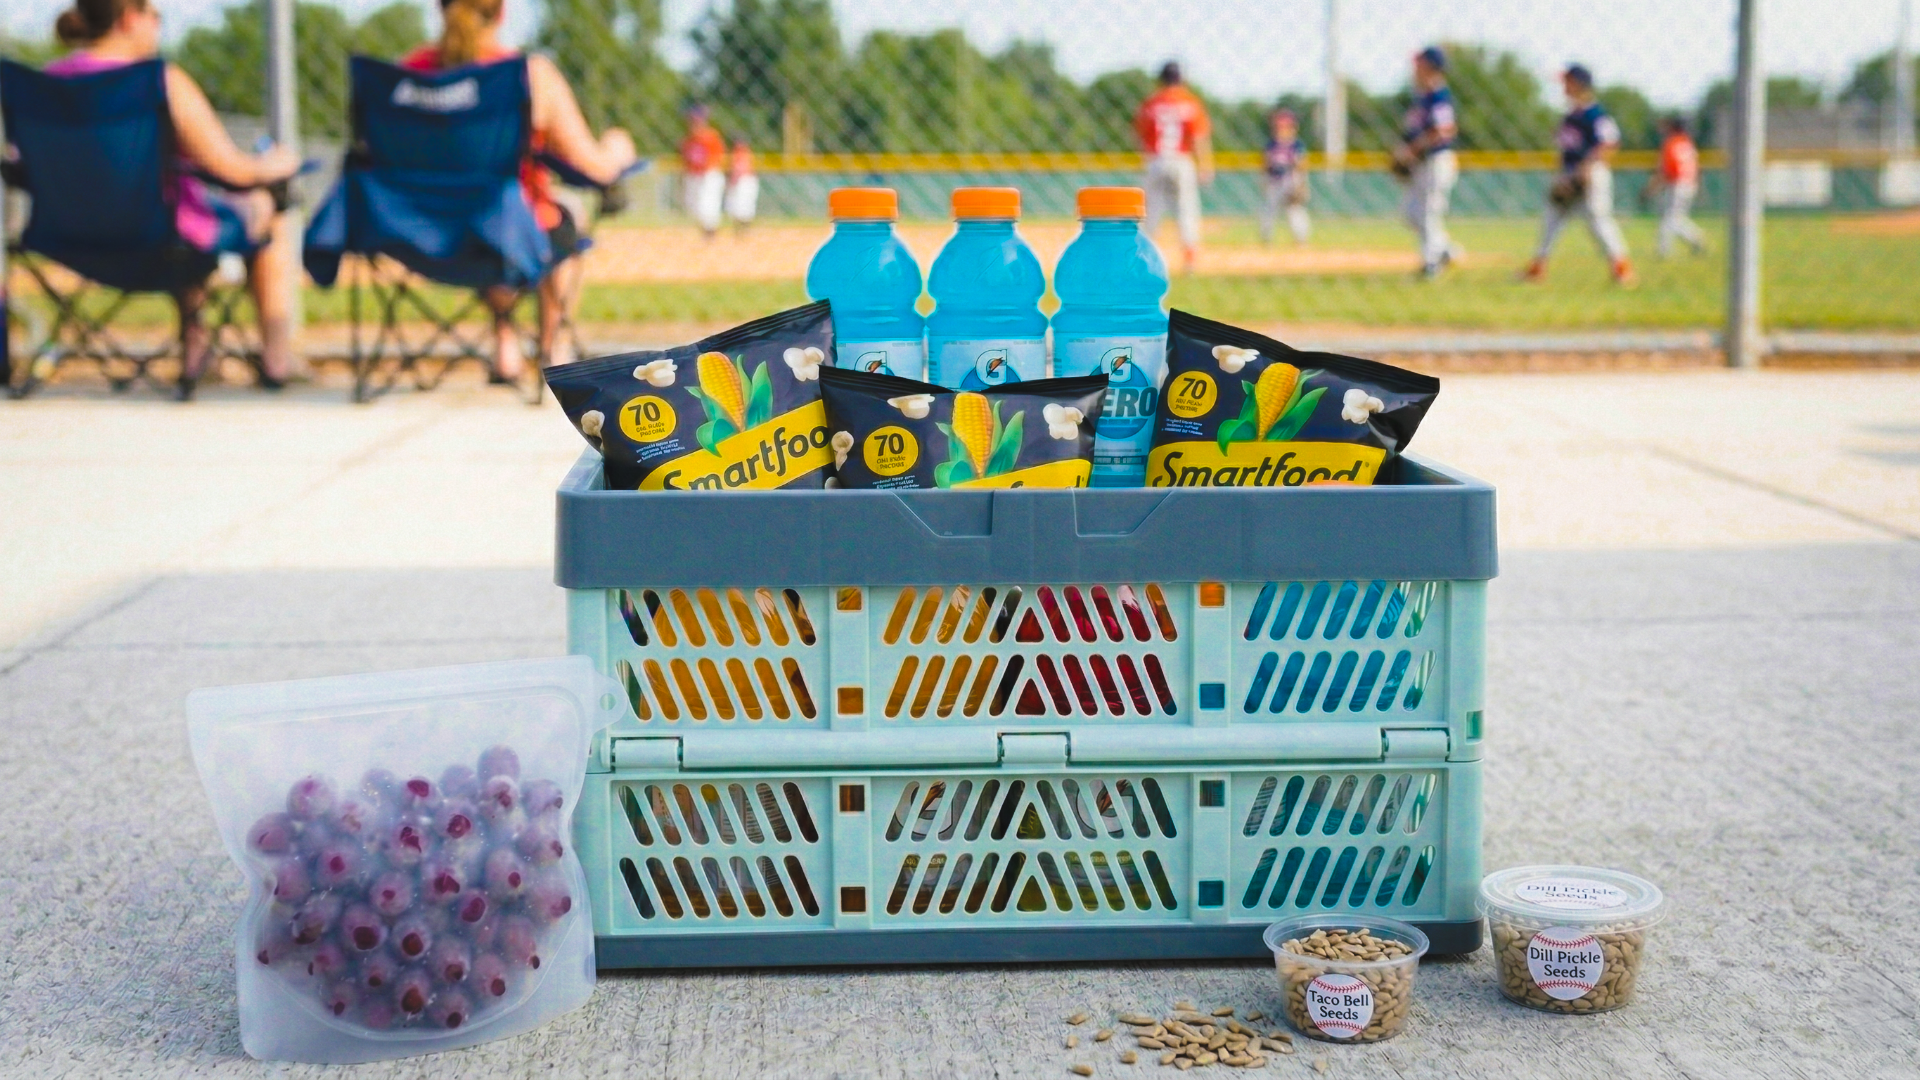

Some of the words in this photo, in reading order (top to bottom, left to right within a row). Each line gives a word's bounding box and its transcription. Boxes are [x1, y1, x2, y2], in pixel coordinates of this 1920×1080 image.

[975, 348, 1008, 387] G
[1100, 346, 1133, 383] G
[1179, 377, 1207, 400] 70
[627, 401, 661, 426] 70
[874, 433, 905, 457] 70
[1152, 451, 1363, 488] Smartfood
[1545, 891, 1597, 900] Seeds
[1564, 886, 1618, 895] Pickle
[1530, 946, 1553, 962] Dill
[1557, 950, 1601, 964] Pickle
[1544, 964, 1586, 979] Seeds
[1309, 990, 1340, 1006] Taco
[1343, 994, 1369, 1007] Bell
[1320, 1005, 1359, 1020] Seeds
